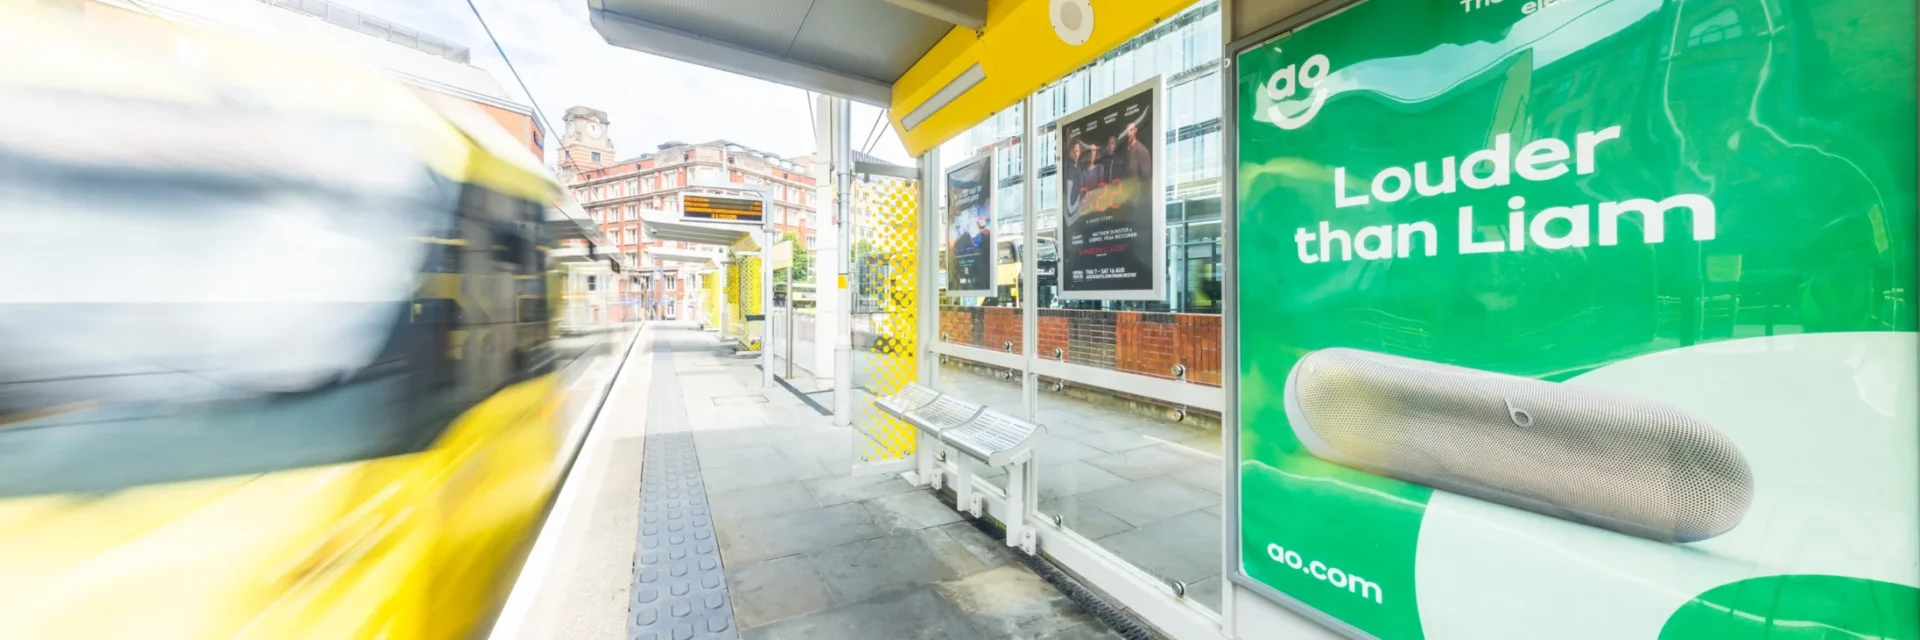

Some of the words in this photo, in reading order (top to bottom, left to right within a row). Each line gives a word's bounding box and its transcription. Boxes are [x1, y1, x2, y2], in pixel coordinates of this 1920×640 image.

[1267, 53, 1330, 100] ao
[1334, 125, 1621, 208] Louder
[1294, 218, 1437, 264] than
[1458, 193, 1716, 255] Liam
[1266, 543, 1383, 604] ao.com
